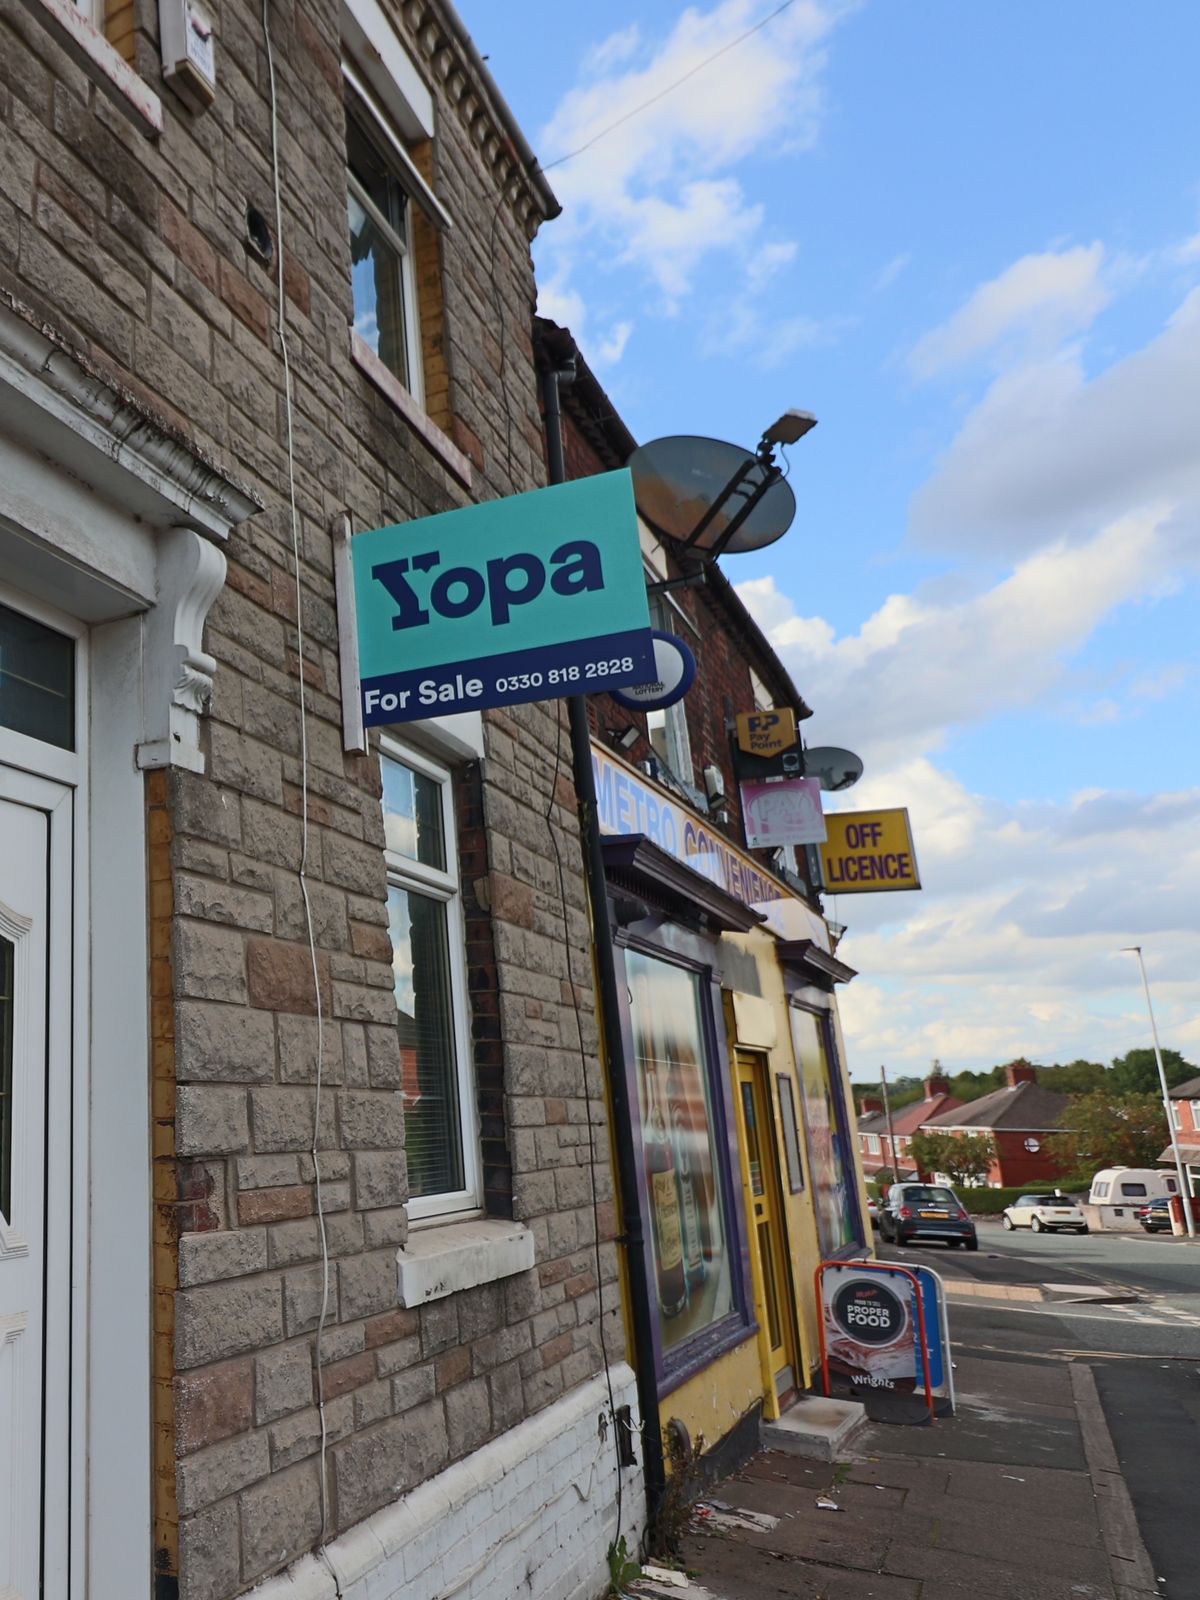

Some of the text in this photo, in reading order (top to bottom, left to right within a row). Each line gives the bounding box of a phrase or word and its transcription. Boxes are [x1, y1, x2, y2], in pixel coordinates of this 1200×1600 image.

[371, 540, 605, 632] Yopa
[364, 656, 634, 715] For Sale 0330 818 2828
[634, 687, 664, 696] LOTTERY
[750, 733, 770, 743] Pay
[751, 739, 783, 750] Point
[591, 754, 678, 859] METRO
[845, 822, 883, 849] OFF
[827, 853, 912, 883] LICENCE
[847, 1305, 889, 1317] PROPER
[847, 1313, 891, 1328] FOOD
[851, 1375, 895, 1389] Wrights
